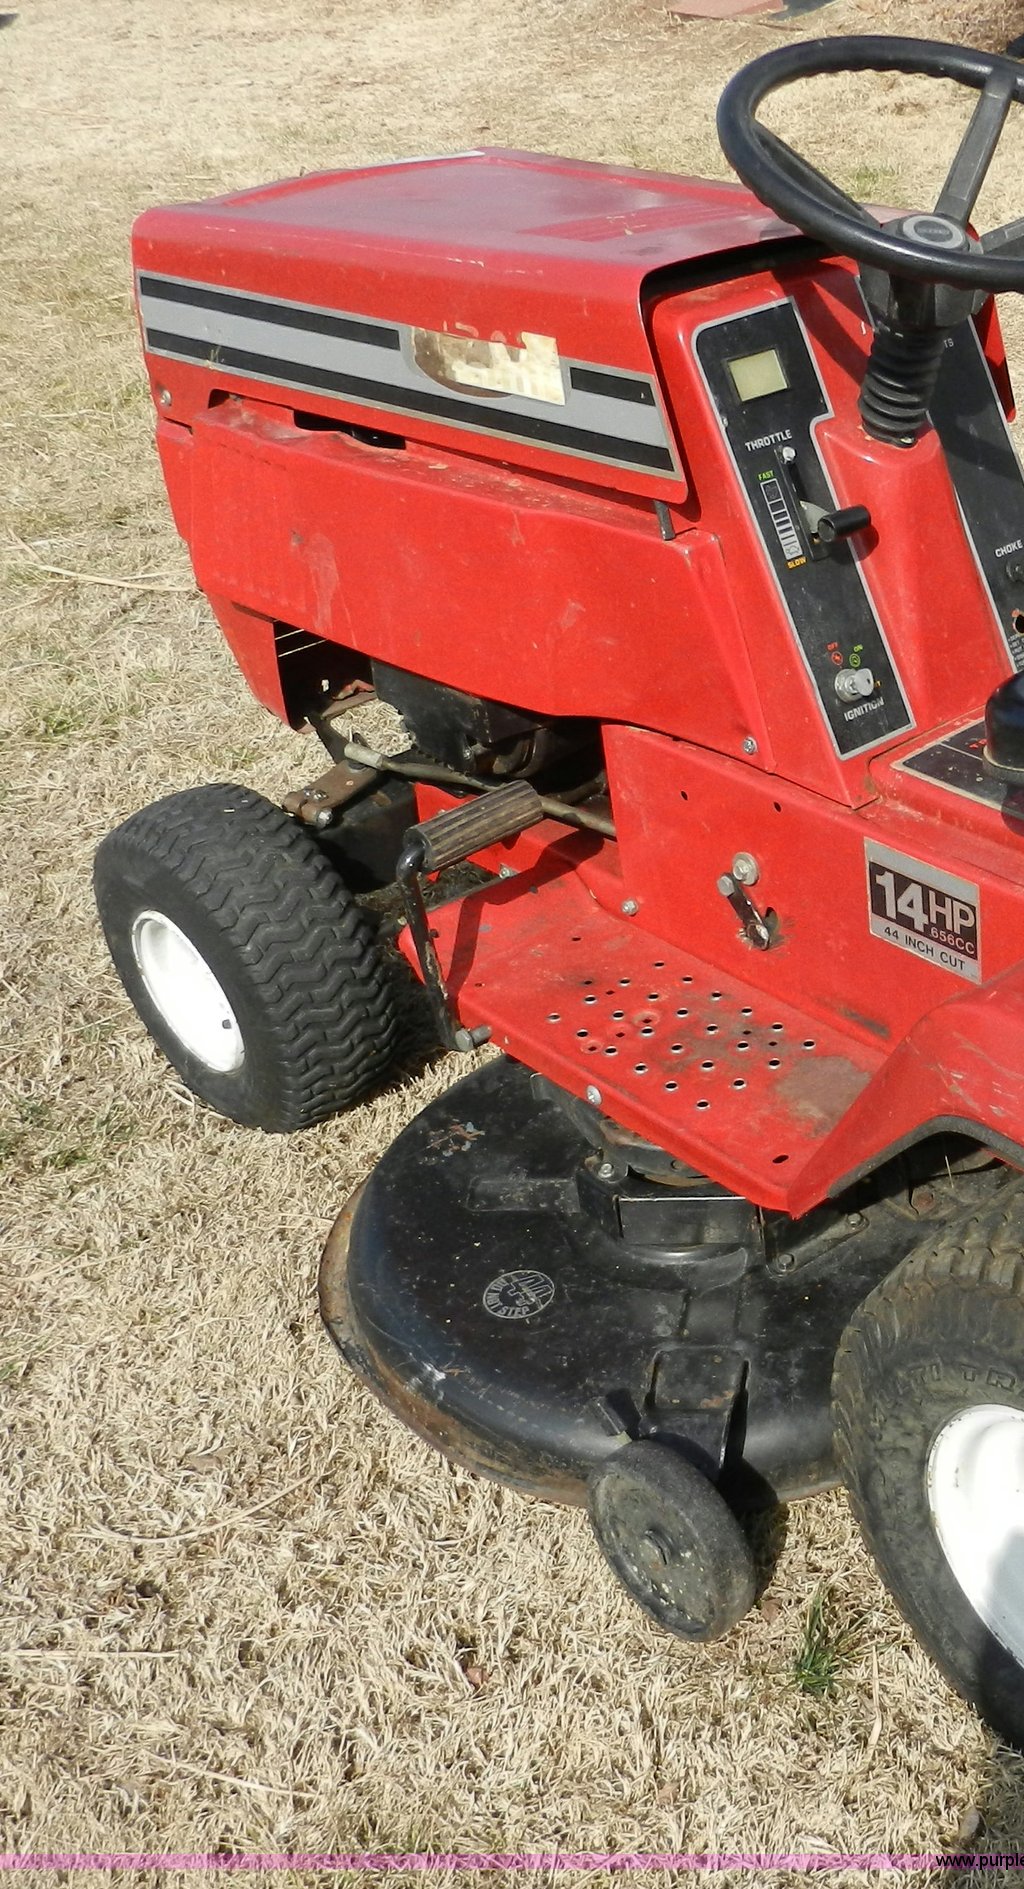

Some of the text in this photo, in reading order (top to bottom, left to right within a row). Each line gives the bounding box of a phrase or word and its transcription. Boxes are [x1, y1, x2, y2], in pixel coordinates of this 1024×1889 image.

[745, 429, 793, 451] THROTTLE
[758, 470, 774, 480] FAST
[995, 540, 1023, 558] CHOKE
[787, 557, 807, 569] SLOW
[827, 642, 838, 651] OFF
[854, 644, 863, 652] ON
[844, 696, 885, 721] IGNITION
[930, 926, 976, 955] 656CC
[884, 926, 966, 971] 44 INCH CUT
[499, 1306, 530, 1317] STEP
